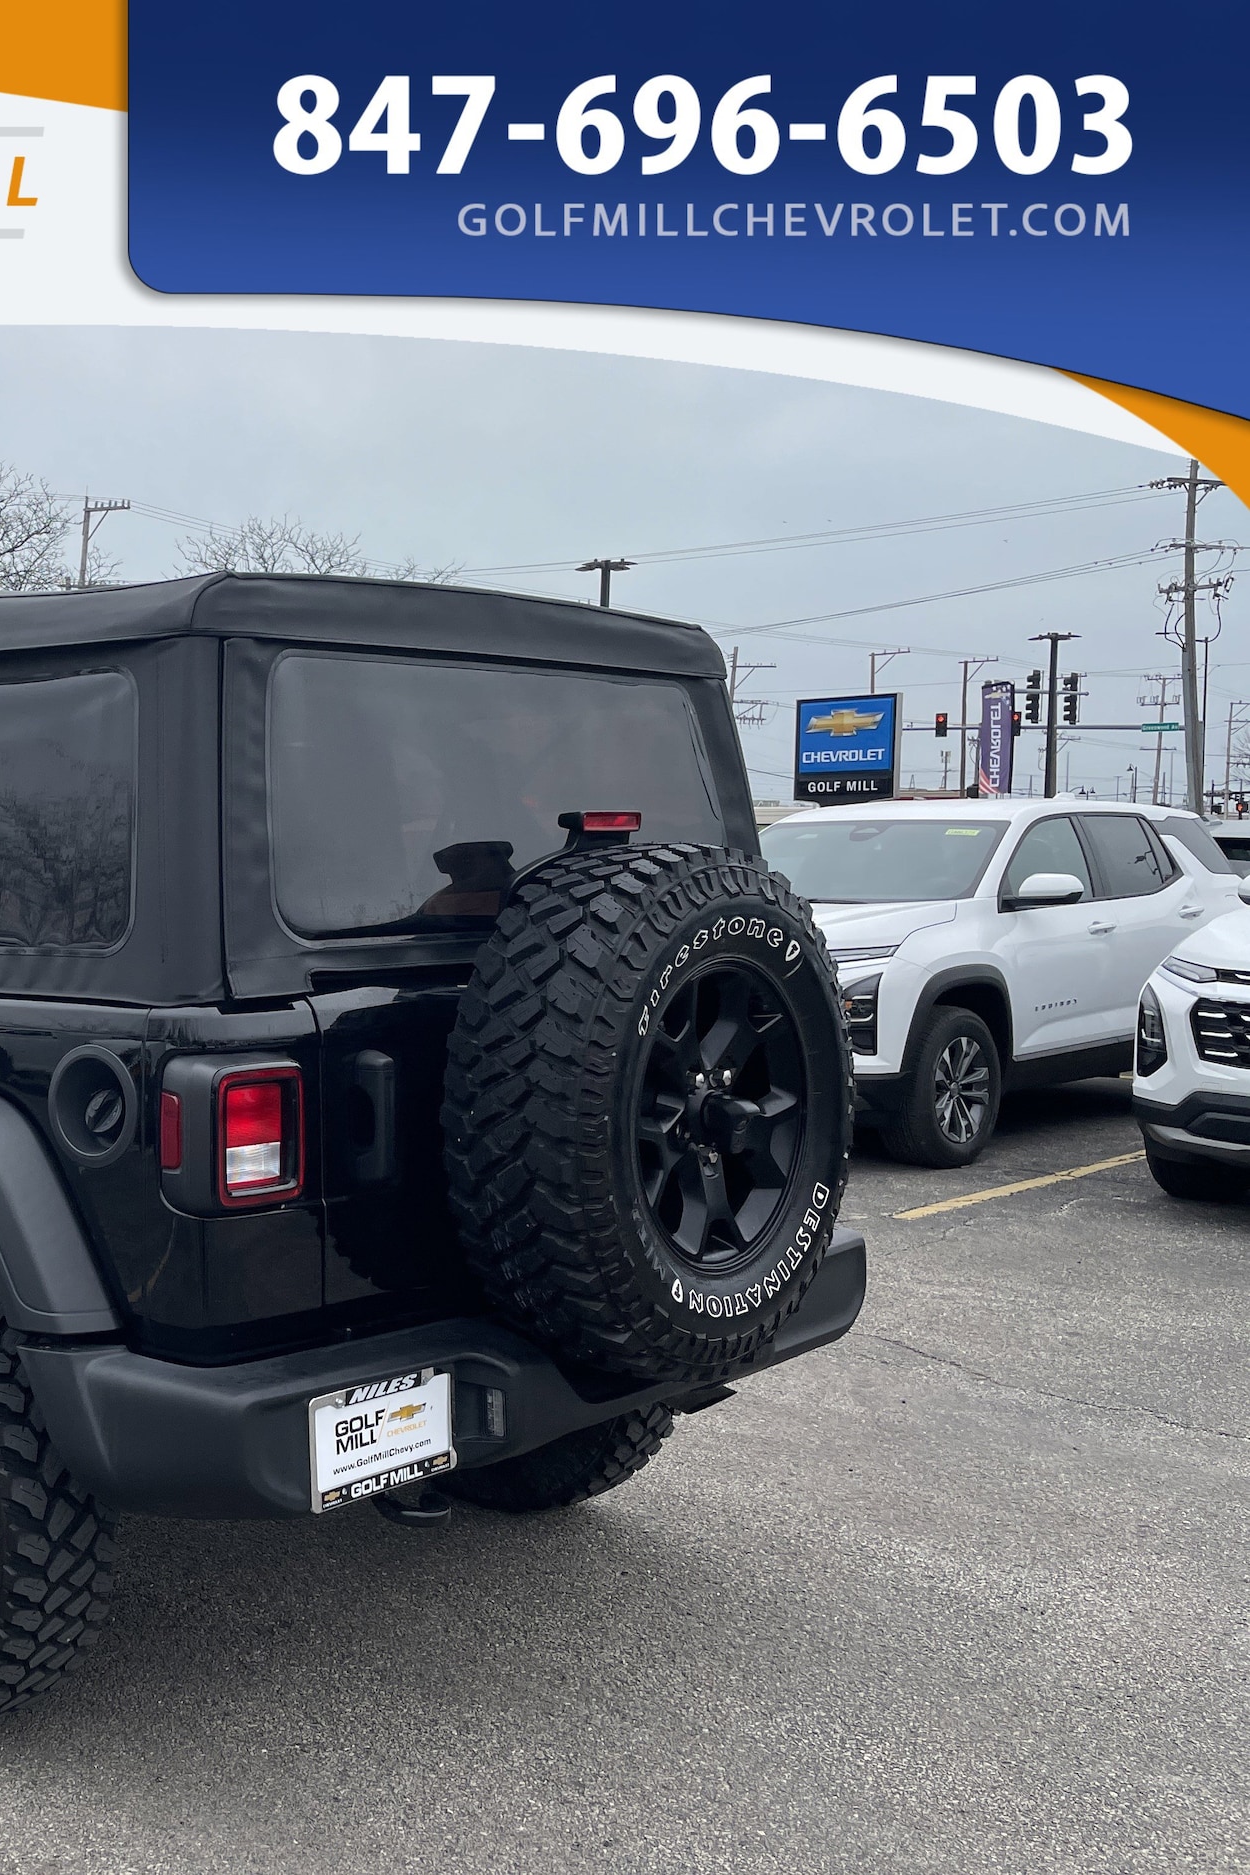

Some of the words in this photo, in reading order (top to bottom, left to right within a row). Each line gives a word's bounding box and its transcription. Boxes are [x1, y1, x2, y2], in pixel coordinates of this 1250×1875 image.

[802, 748, 886, 764] CHEVROLET
[807, 781, 841, 793] GOLF
[846, 780, 878, 792] MILL
[638, 915, 784, 1038] Firestone
[689, 1181, 830, 1319] DESTINATION
[349, 1373, 418, 1405] NILES
[335, 1408, 386, 1438] GOLF
[386, 1420, 427, 1438] CHEVROLET
[333, 1437, 432, 1475] www.GolfMillChevy.com
[336, 1429, 378, 1455] MILL
[350, 1473, 389, 1499] GOLF
[390, 1463, 424, 1487] MILL
